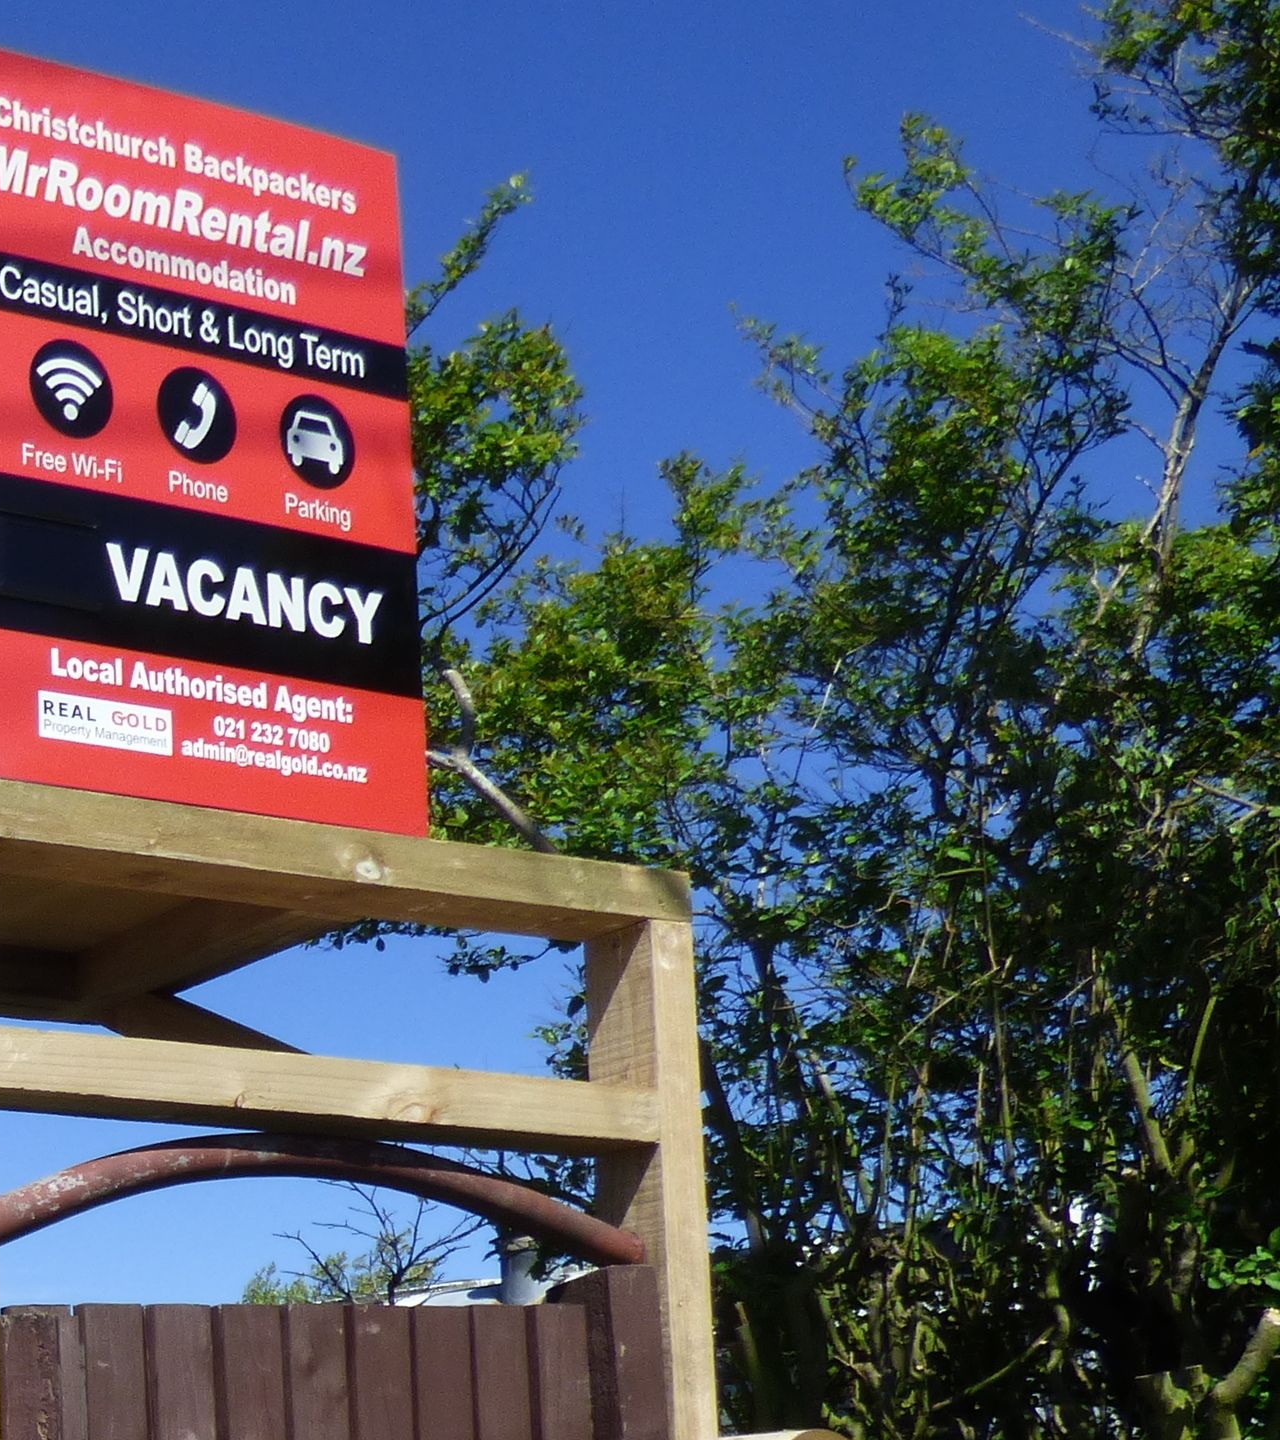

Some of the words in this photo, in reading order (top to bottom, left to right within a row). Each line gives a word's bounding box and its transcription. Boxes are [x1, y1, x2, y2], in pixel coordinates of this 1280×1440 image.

[184, 143, 357, 215] Backpackers
[72, 226, 296, 305] Accommodation
[117, 292, 191, 339] Short
[199, 310, 220, 345] &
[228, 316, 293, 369] Long
[300, 333, 365, 378] Term
[22, 443, 66, 474] Free
[72, 453, 123, 483] Wi-Fi
[168, 471, 228, 502] Phone
[285, 492, 352, 531] Parking
[106, 542, 383, 645] VACANCY
[50, 647, 122, 686] Local
[130, 661, 268, 709] Authorised
[274, 685, 354, 724] Agent:
[43, 699, 97, 722] REAL
[111, 711, 167, 732] GOLD
[43, 719, 91, 740] Property
[94, 727, 168, 749] Management
[213, 715, 245, 740] 021
[251, 722, 284, 746] 232
[287, 728, 330, 753] 7080
[181, 738, 368, 784] admin@realgold.co.nz
